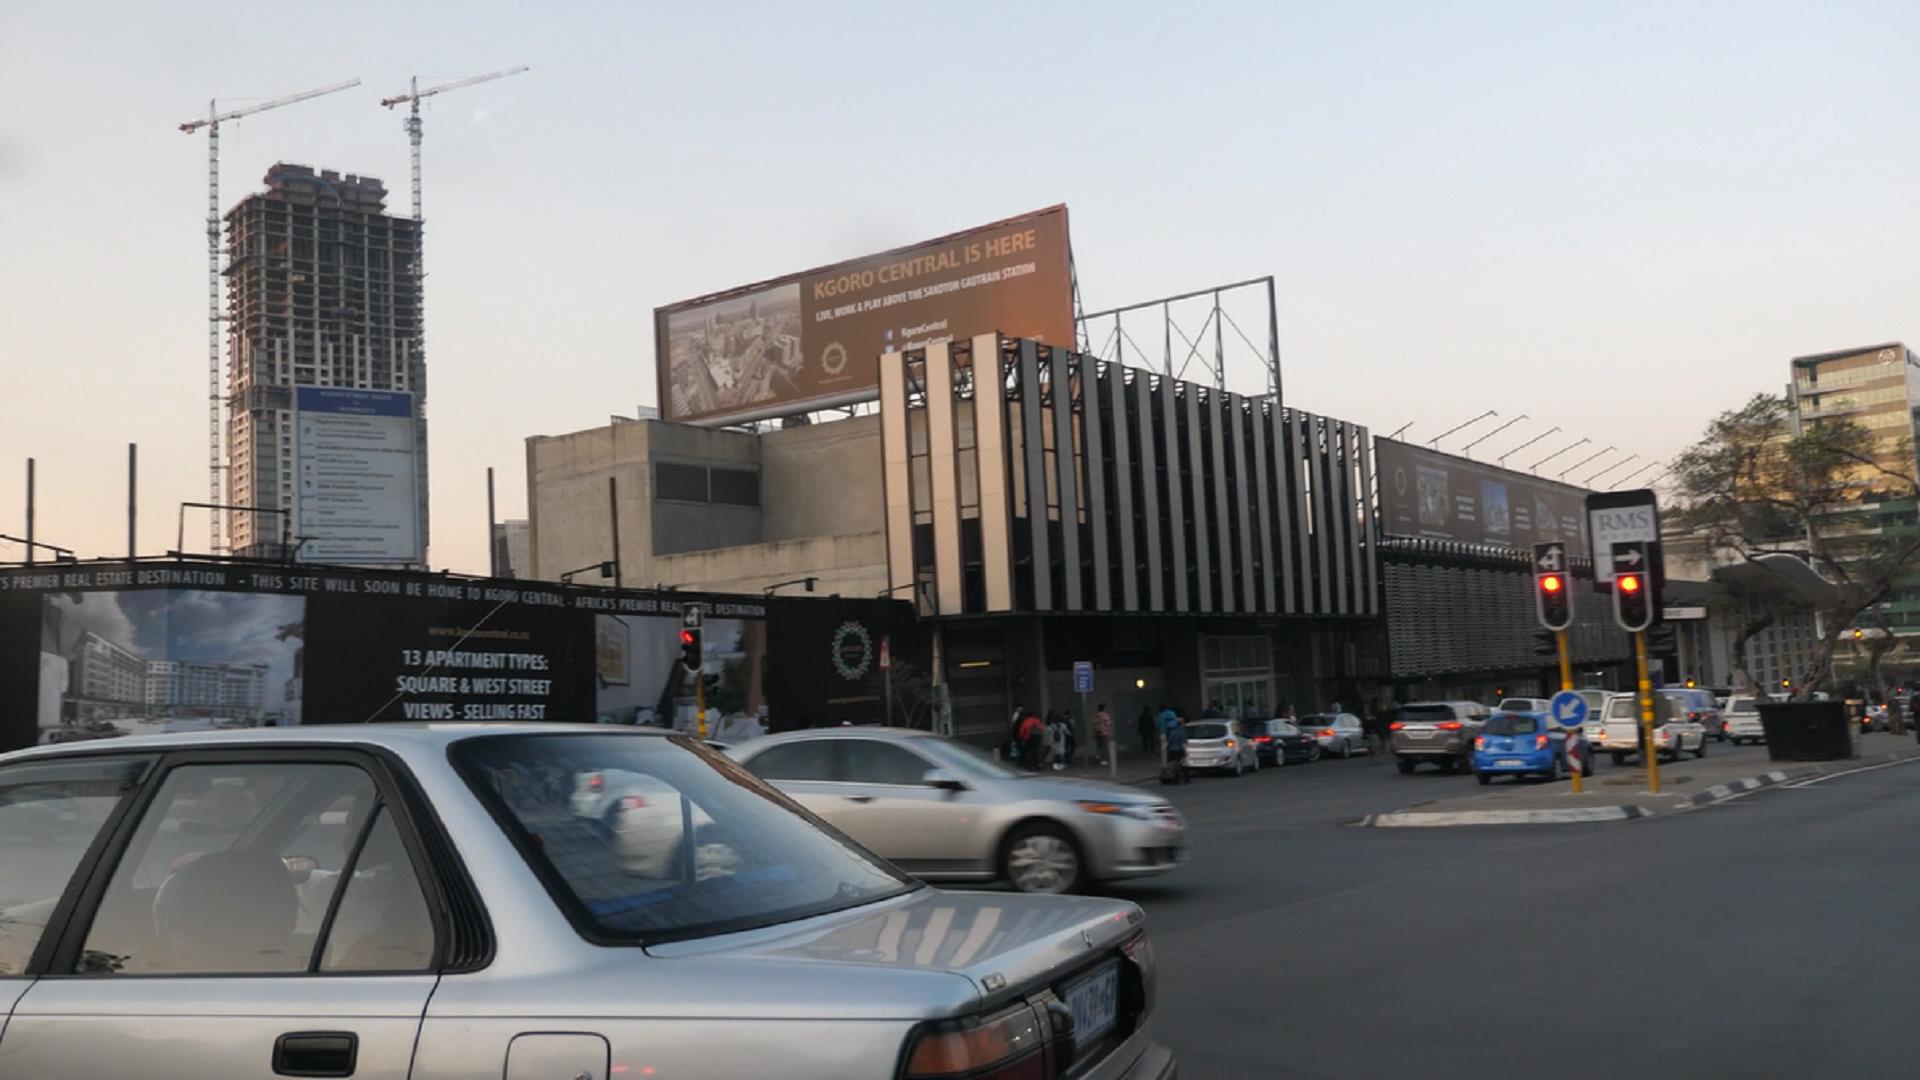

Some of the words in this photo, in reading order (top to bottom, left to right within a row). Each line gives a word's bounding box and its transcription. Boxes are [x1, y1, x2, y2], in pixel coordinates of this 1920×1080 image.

[815, 270, 873, 299] KGORO
[878, 249, 959, 283] CENTRAL
[964, 243, 981, 264] IS
[985, 229, 1036, 258] HERE
[834, 303, 857, 318] WORK
[863, 298, 882, 310] PLAY
[883, 291, 907, 307] ABOVE
[907, 287, 923, 300] THE
[923, 280, 959, 297] SANDTON
[961, 271, 1000, 289] GAUTRAIN
[1002, 262, 1035, 280] STATION
[1599, 511, 1649, 531] RMS
[12, 575, 59, 589] PREMIER
[64, 573, 91, 587] REAL
[96, 571, 133, 586] ESTATE
[137, 569, 225, 585] DESTINATION
[251, 574, 284, 589] THIS
[289, 576, 319, 590] SITE
[324, 578, 358, 593] WILL
[363, 580, 401, 594] SOON
[406, 582, 422, 597] BE
[428, 584, 463, 599] HOME
[467, 587, 481, 600] TO
[521, 590, 565, 608] CENTRAL
[575, 596, 616, 610] AFRICA'S
[618, 598, 657, 612] PREMIER
[715, 603, 765, 616] DESTINATION
[402, 650, 421, 665] 13
[425, 650, 505, 669] APARTMENT
[508, 653, 550, 670] TYPES:
[397, 675, 457, 694] SQUARE
[459, 678, 470, 693] &
[472, 678, 507, 694] WEST
[508, 679, 552, 695] STREET
[403, 702, 454, 719] VIEWS
[463, 703, 515, 720] SELLING
[517, 704, 546, 719] FAST
